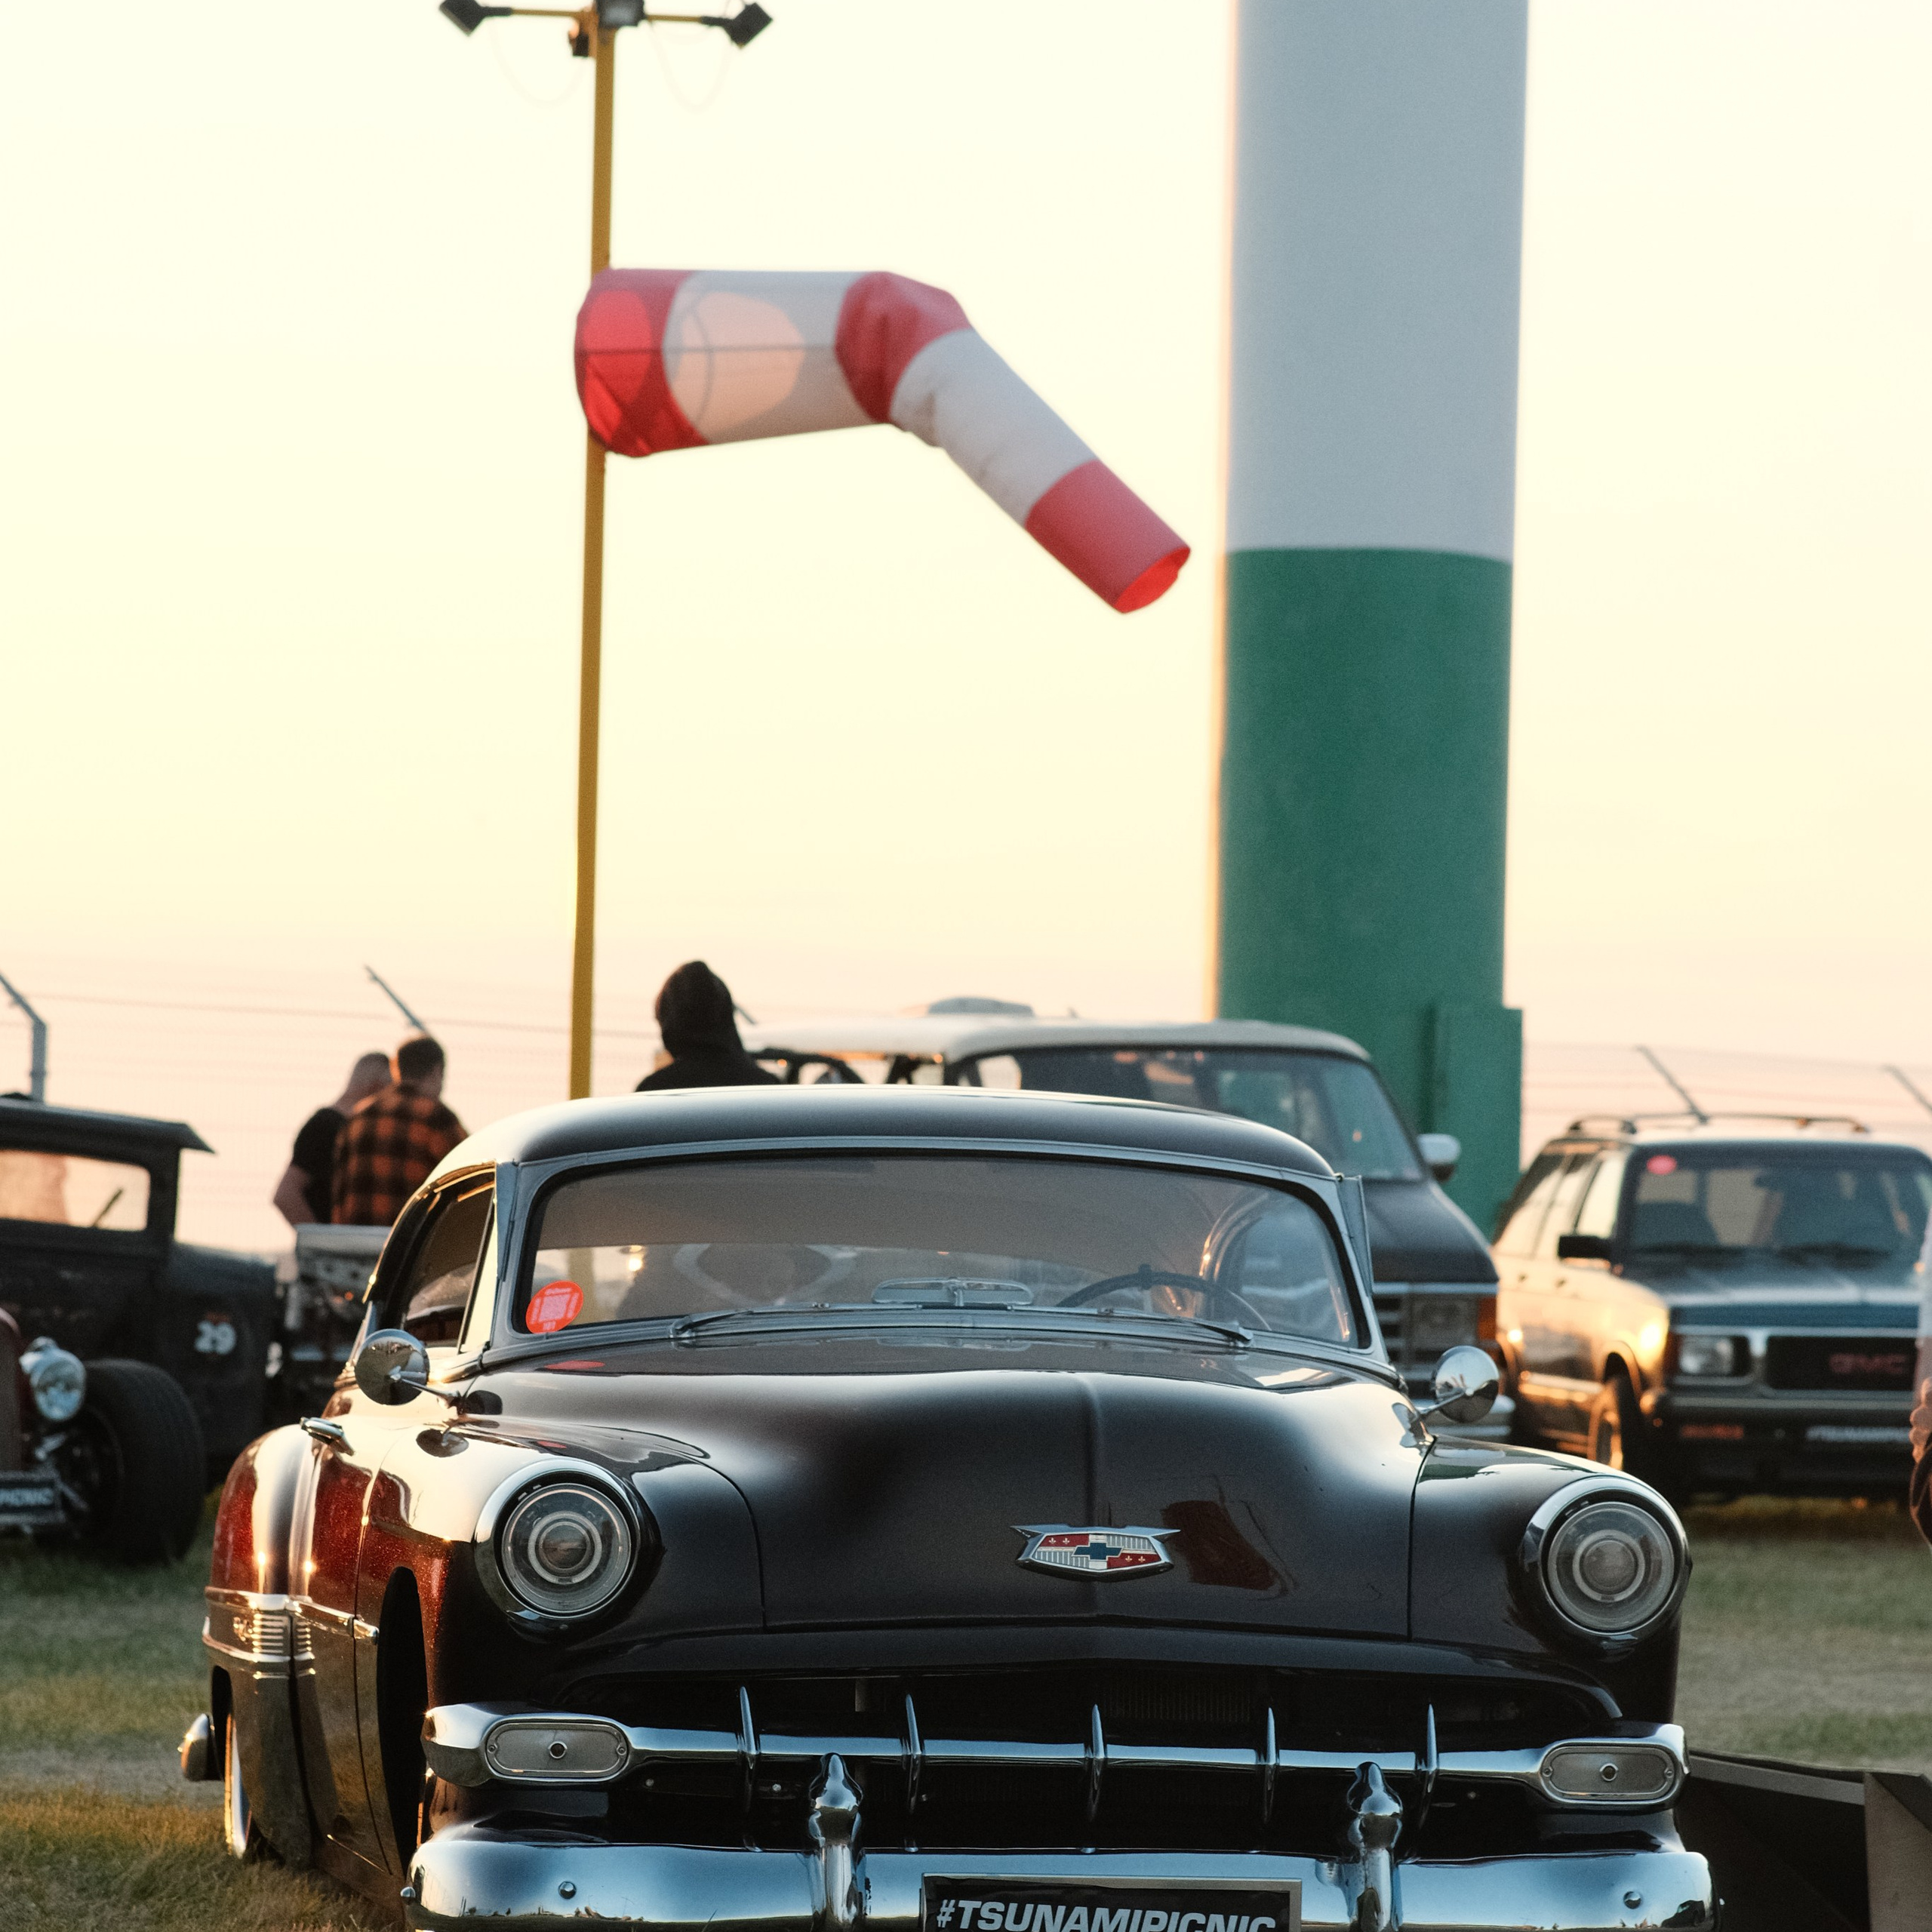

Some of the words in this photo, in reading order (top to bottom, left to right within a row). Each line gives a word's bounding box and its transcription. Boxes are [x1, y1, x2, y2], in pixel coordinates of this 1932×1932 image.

[195, 1320, 235, 1354] 29
[1829, 1353, 1905, 1374] GMC
[937, 1900, 1275, 1932] #TSUNAMIPICNIC
